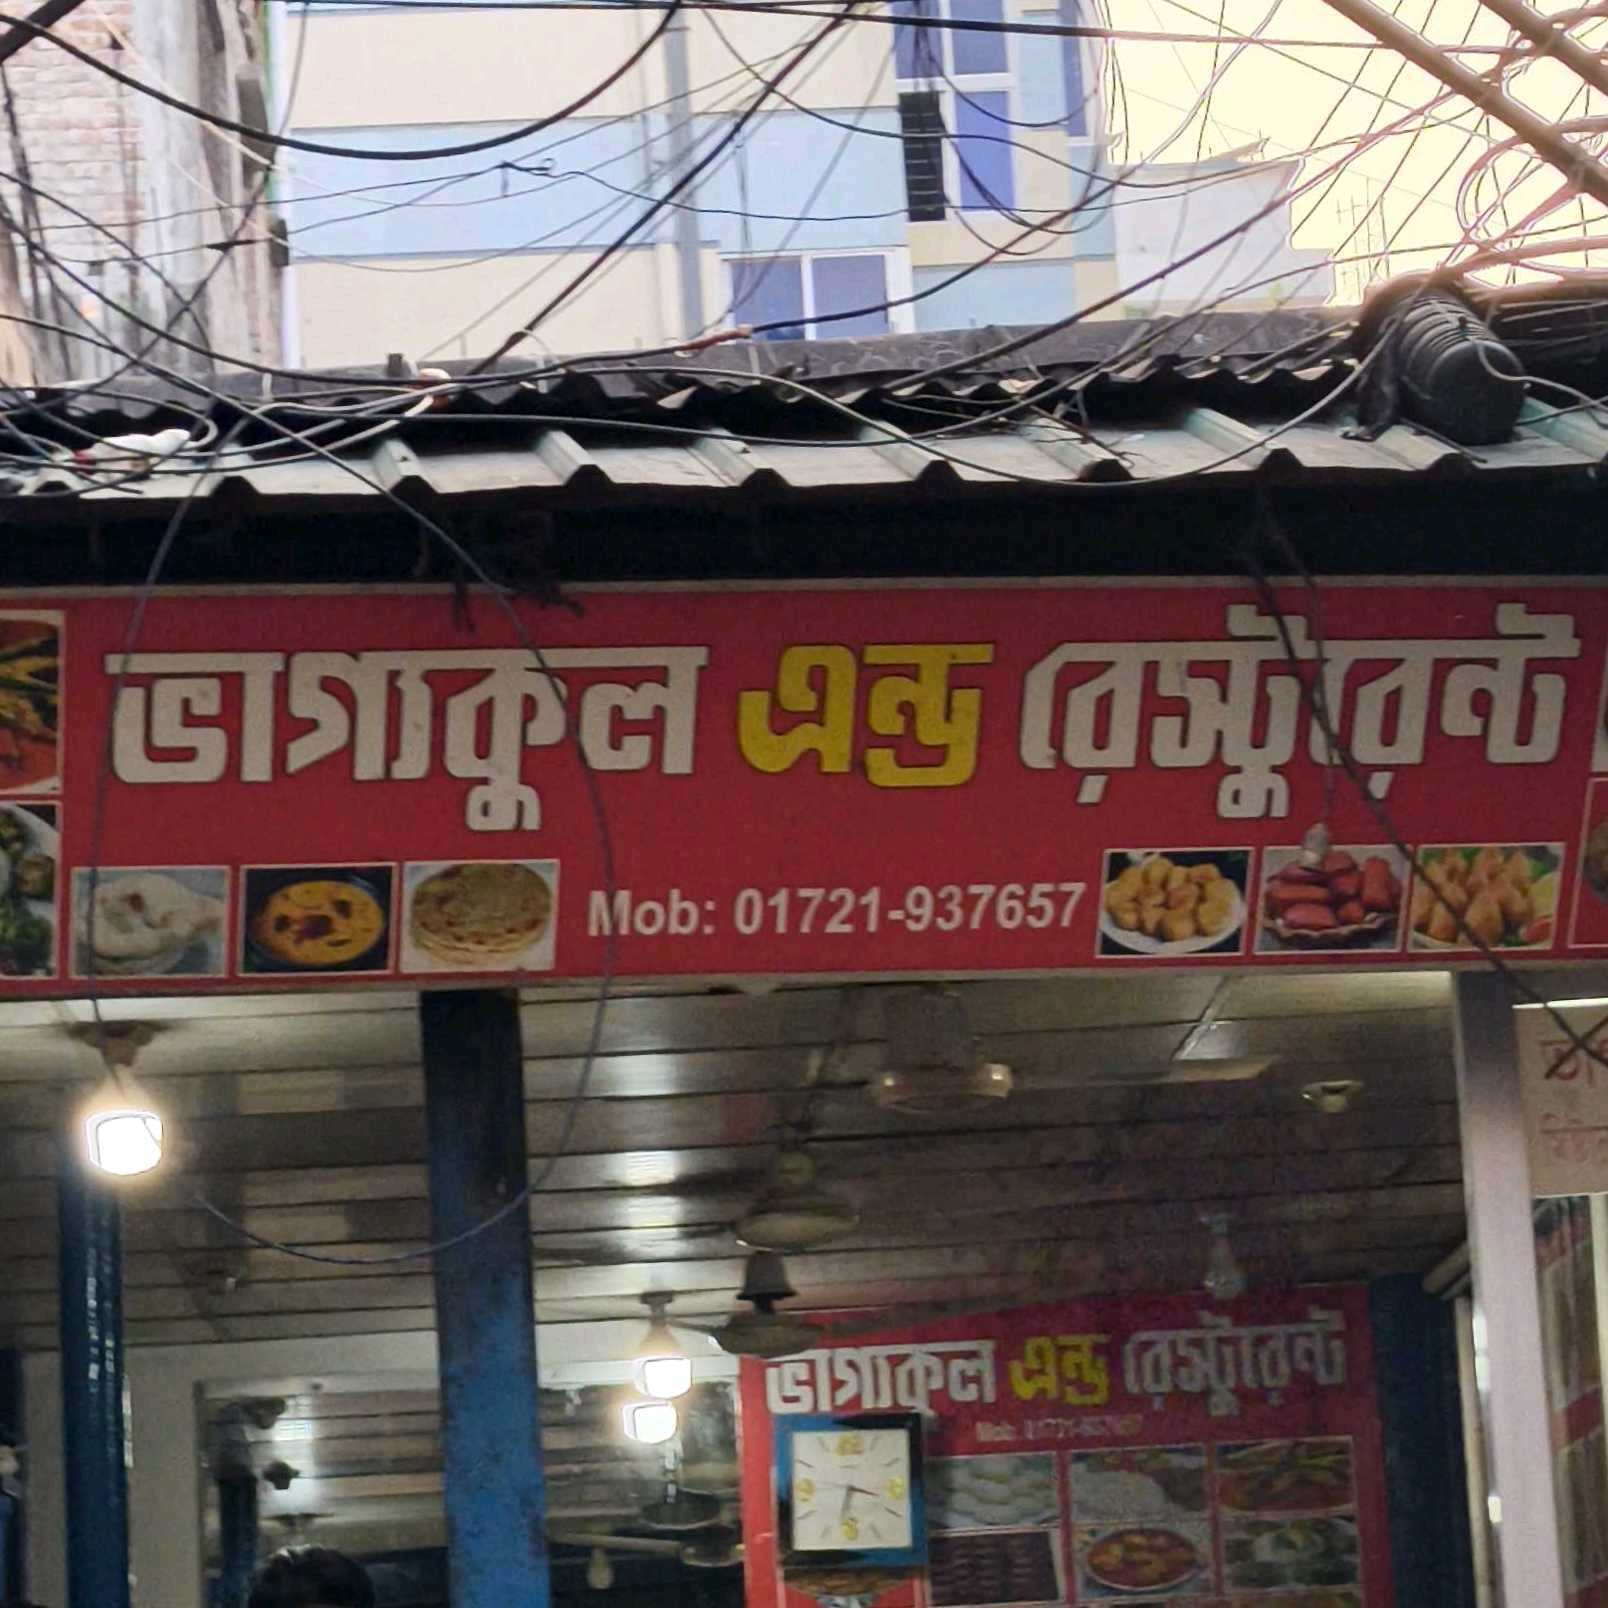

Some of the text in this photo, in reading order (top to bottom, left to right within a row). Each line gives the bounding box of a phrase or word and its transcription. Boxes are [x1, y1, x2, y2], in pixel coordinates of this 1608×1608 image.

[105, 602, 1581, 832] ভাগ্যকুল এন্ড রেস্টুরেন্ট
[588, 881, 1087, 937] Mob: 01721-937657
